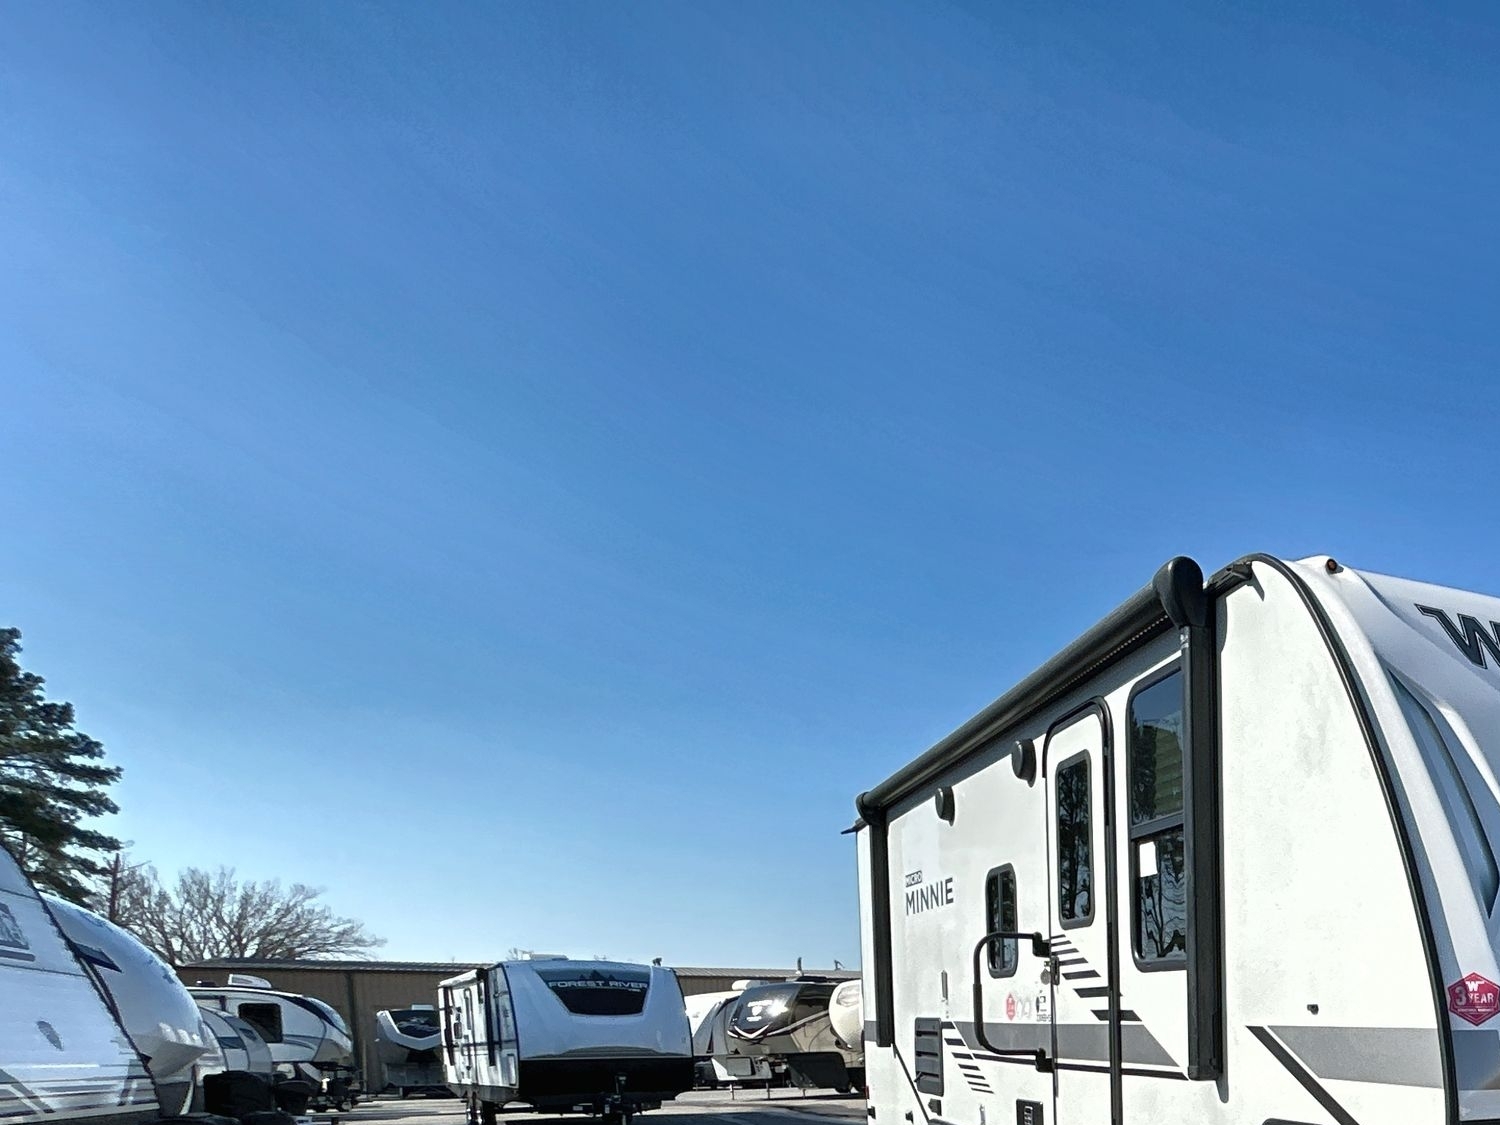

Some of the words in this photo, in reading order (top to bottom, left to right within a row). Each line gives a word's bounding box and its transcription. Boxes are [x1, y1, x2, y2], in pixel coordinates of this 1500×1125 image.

[905, 877, 954, 915] MINNIE
[548, 980, 605, 988] FOREST
[608, 980, 648, 988] RIVER
[1454, 985, 1467, 1006] 3
[1468, 992, 1494, 1004] YEAR
